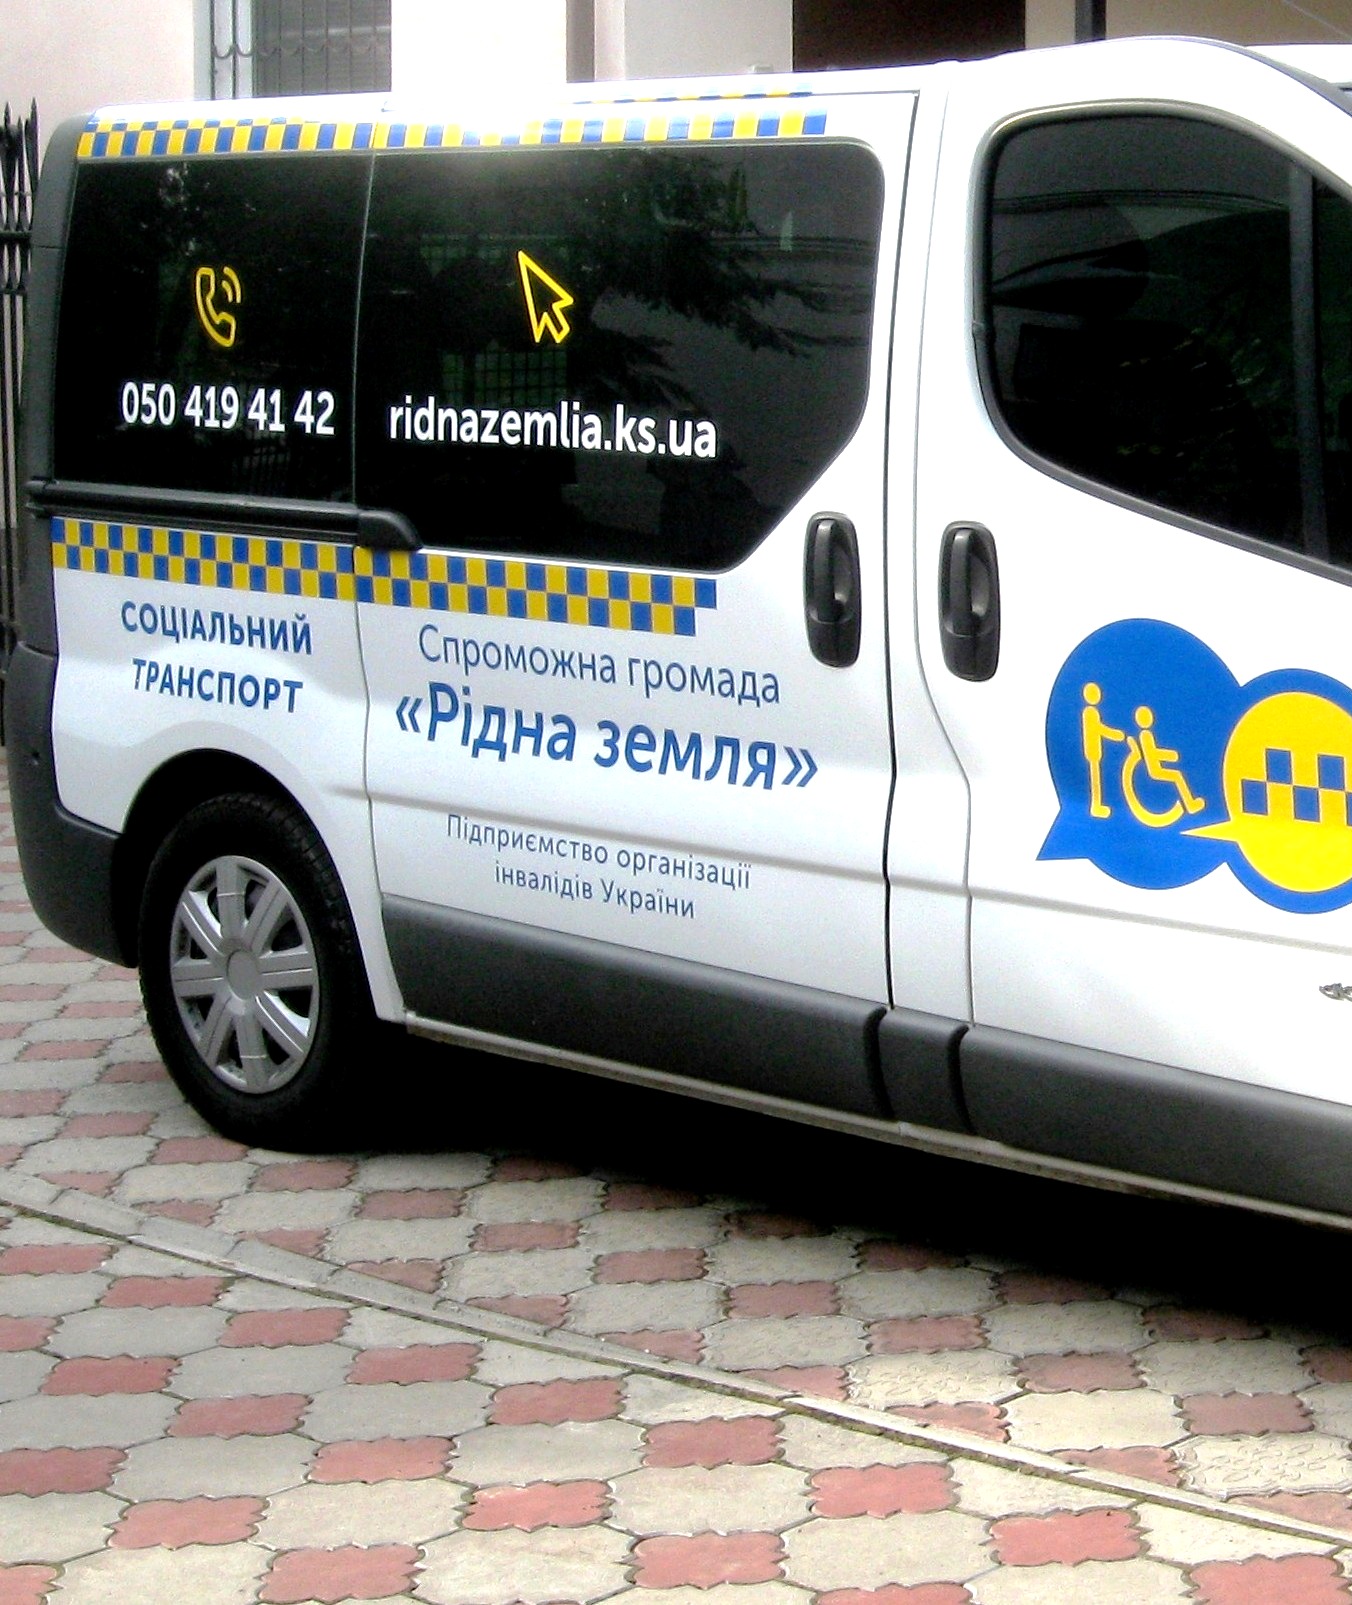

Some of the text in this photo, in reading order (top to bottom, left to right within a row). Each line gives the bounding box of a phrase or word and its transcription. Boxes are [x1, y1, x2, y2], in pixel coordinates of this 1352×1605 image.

[122, 381, 336, 435] 050 419 41 42
[389, 394, 717, 458] ridnazemlia.ks.ua
[121, 601, 312, 655] СОЦІАЛЬНИЙ
[132, 658, 304, 713] ТРАНСПОРТ
[418, 624, 781, 706] Спроможна громада
[395, 681, 819, 790] «Рідна земля»
[447, 814, 752, 891] Підприємство організації
[495, 860, 696, 919] інвалідів України
